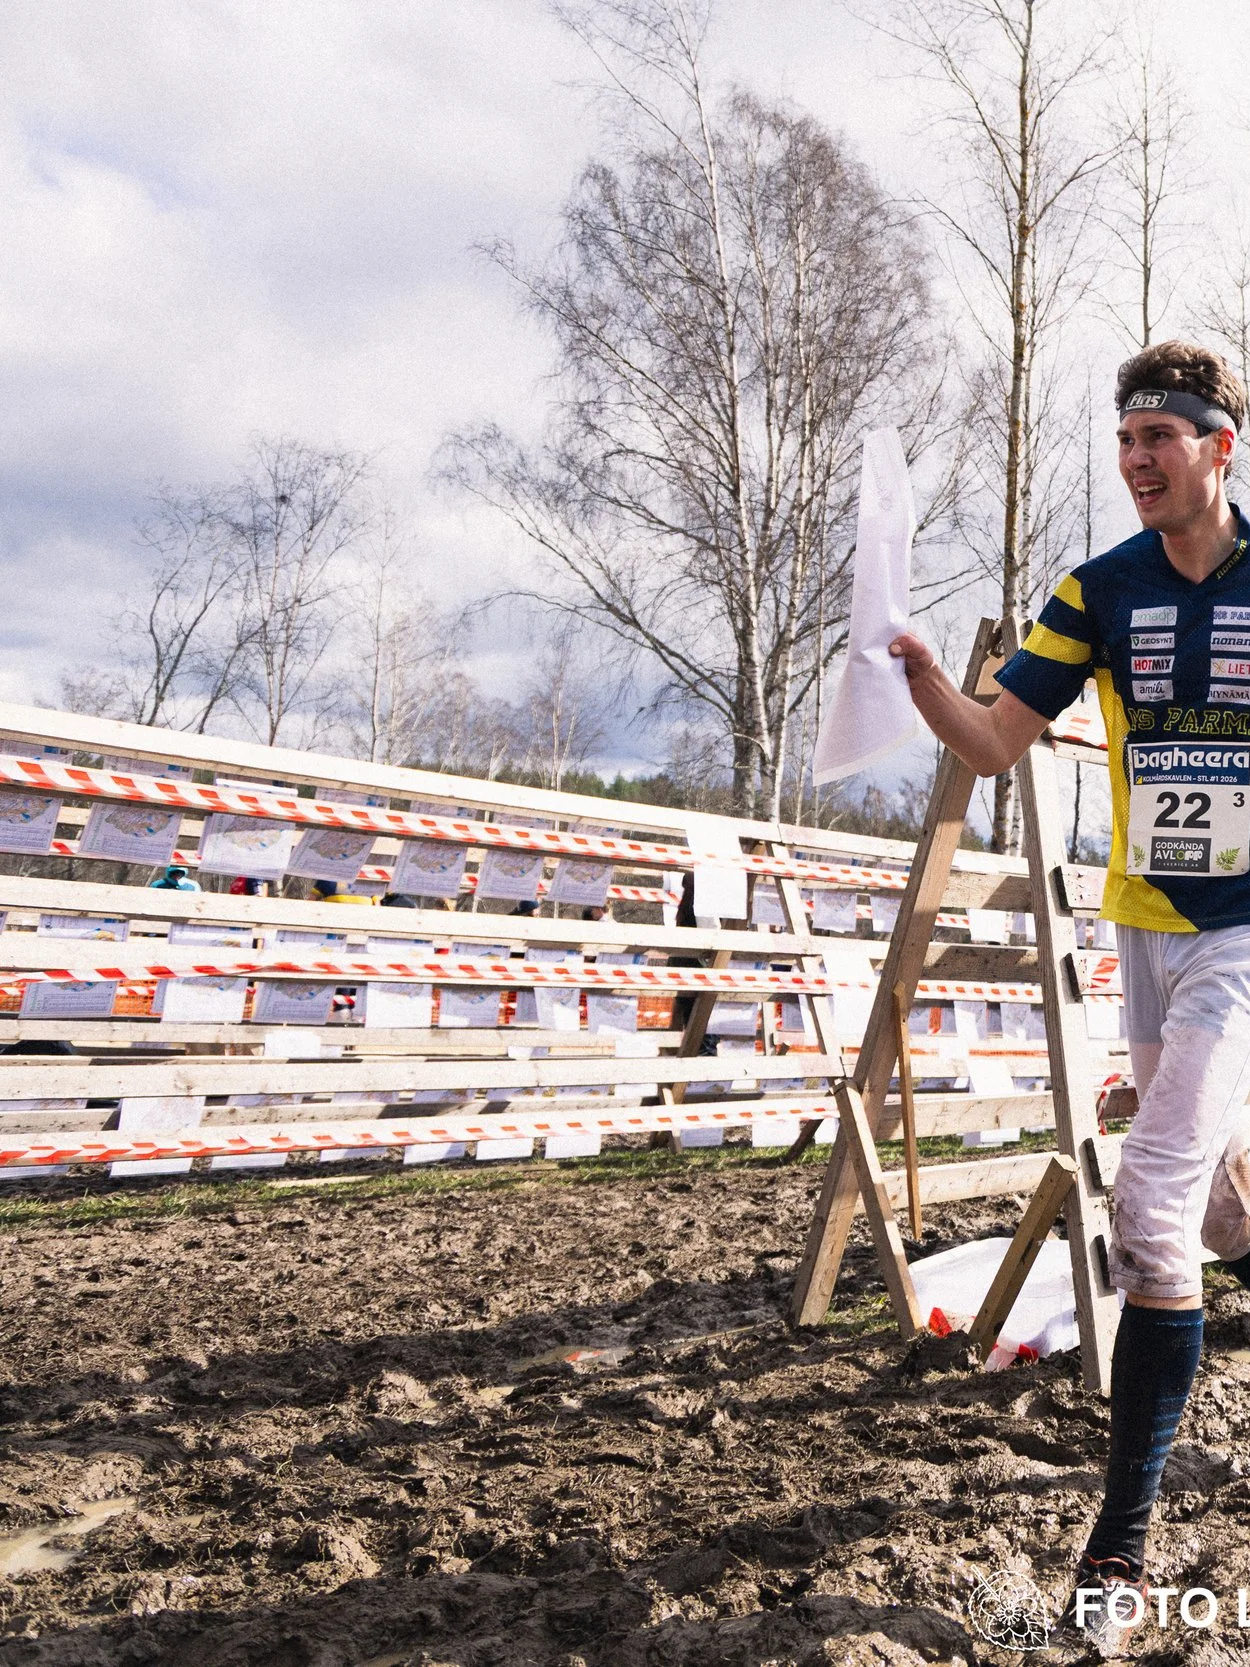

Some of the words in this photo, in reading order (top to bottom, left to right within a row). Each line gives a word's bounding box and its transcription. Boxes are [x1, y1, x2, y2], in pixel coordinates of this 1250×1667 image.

[1134, 659, 1172, 671] HOTMIX
[1133, 747, 1250, 771] bagheera
[1220, 775, 1238, 783] 2026
[1154, 791, 1212, 829] 22
[1232, 792, 1245, 808] 3
[1155, 840, 1205, 851] GODKÄNDA
[1154, 849, 1203, 861] AVLOPP
